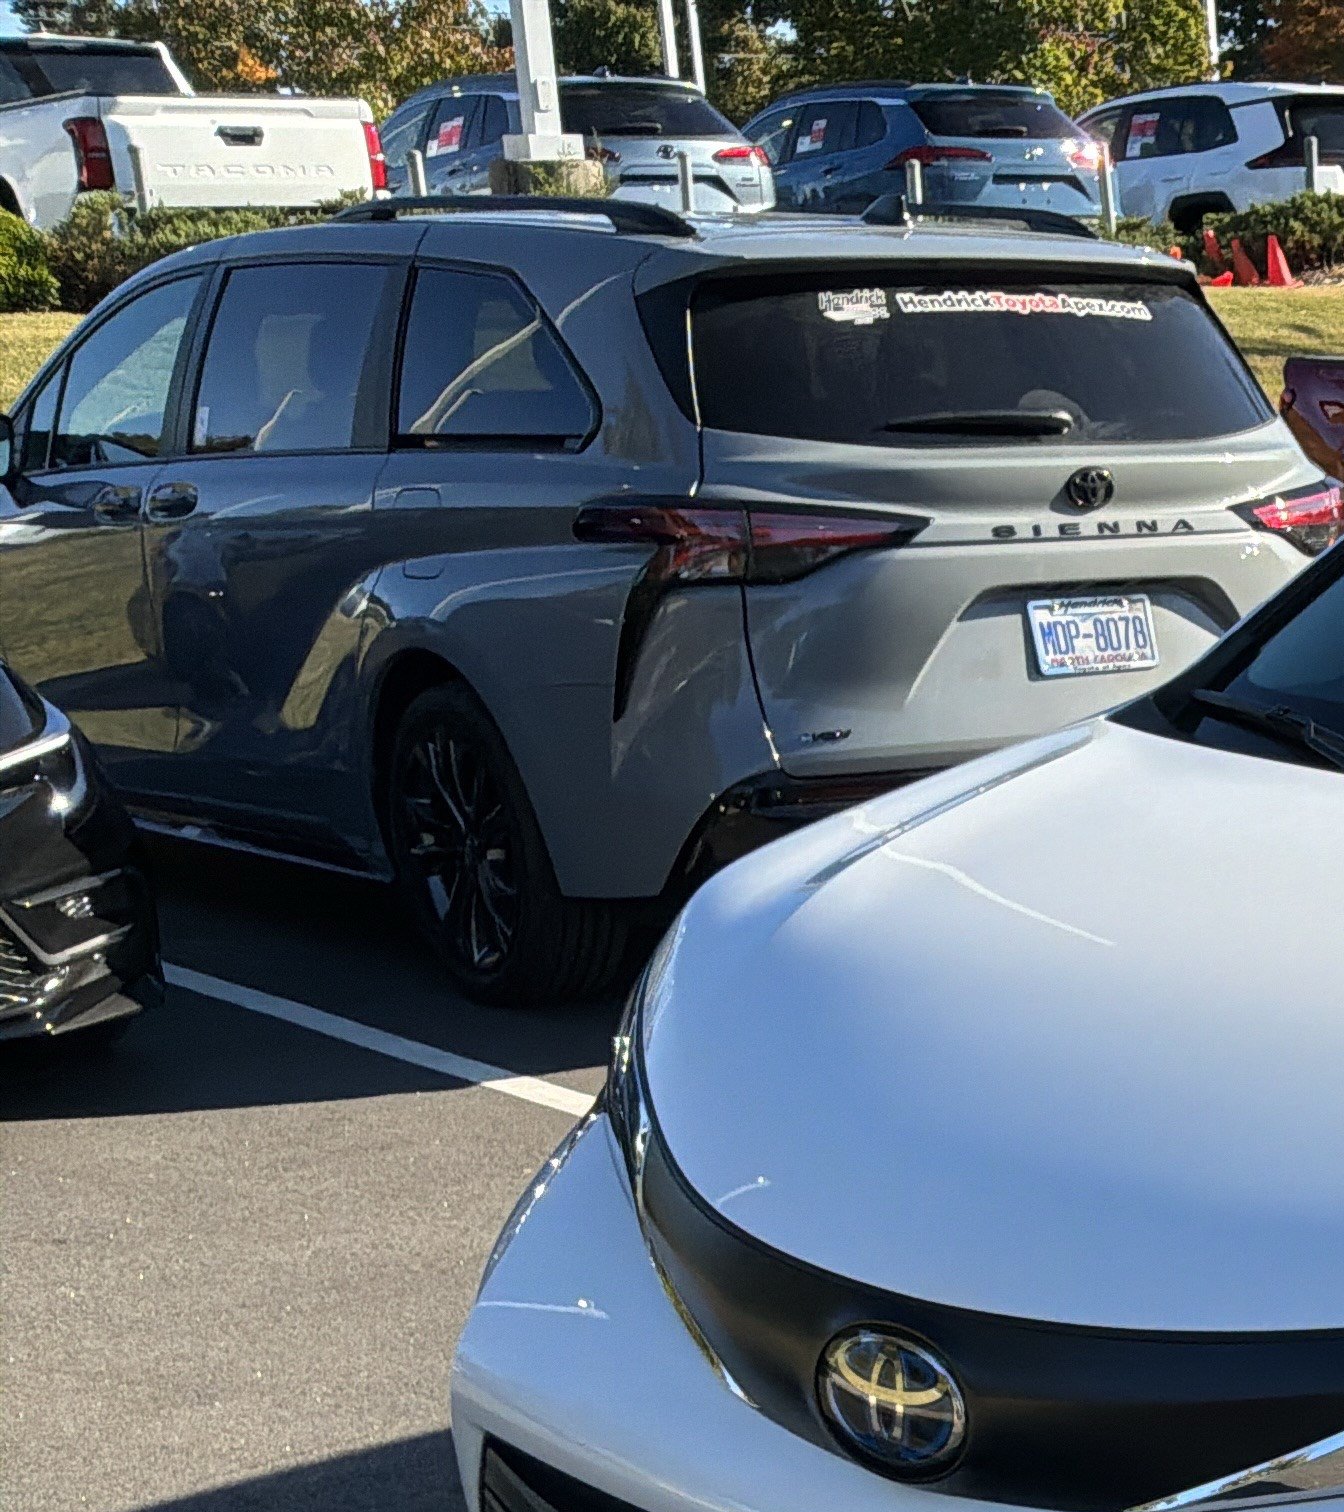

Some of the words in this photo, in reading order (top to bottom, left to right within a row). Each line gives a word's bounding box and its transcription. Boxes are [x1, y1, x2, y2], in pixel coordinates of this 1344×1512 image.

[156, 163, 335, 178] TACOMA
[818, 288, 887, 311] Hendrick
[897, 291, 1152, 320] HendrickToyotaApex.com
[991, 519, 1194, 538] SIENNA
